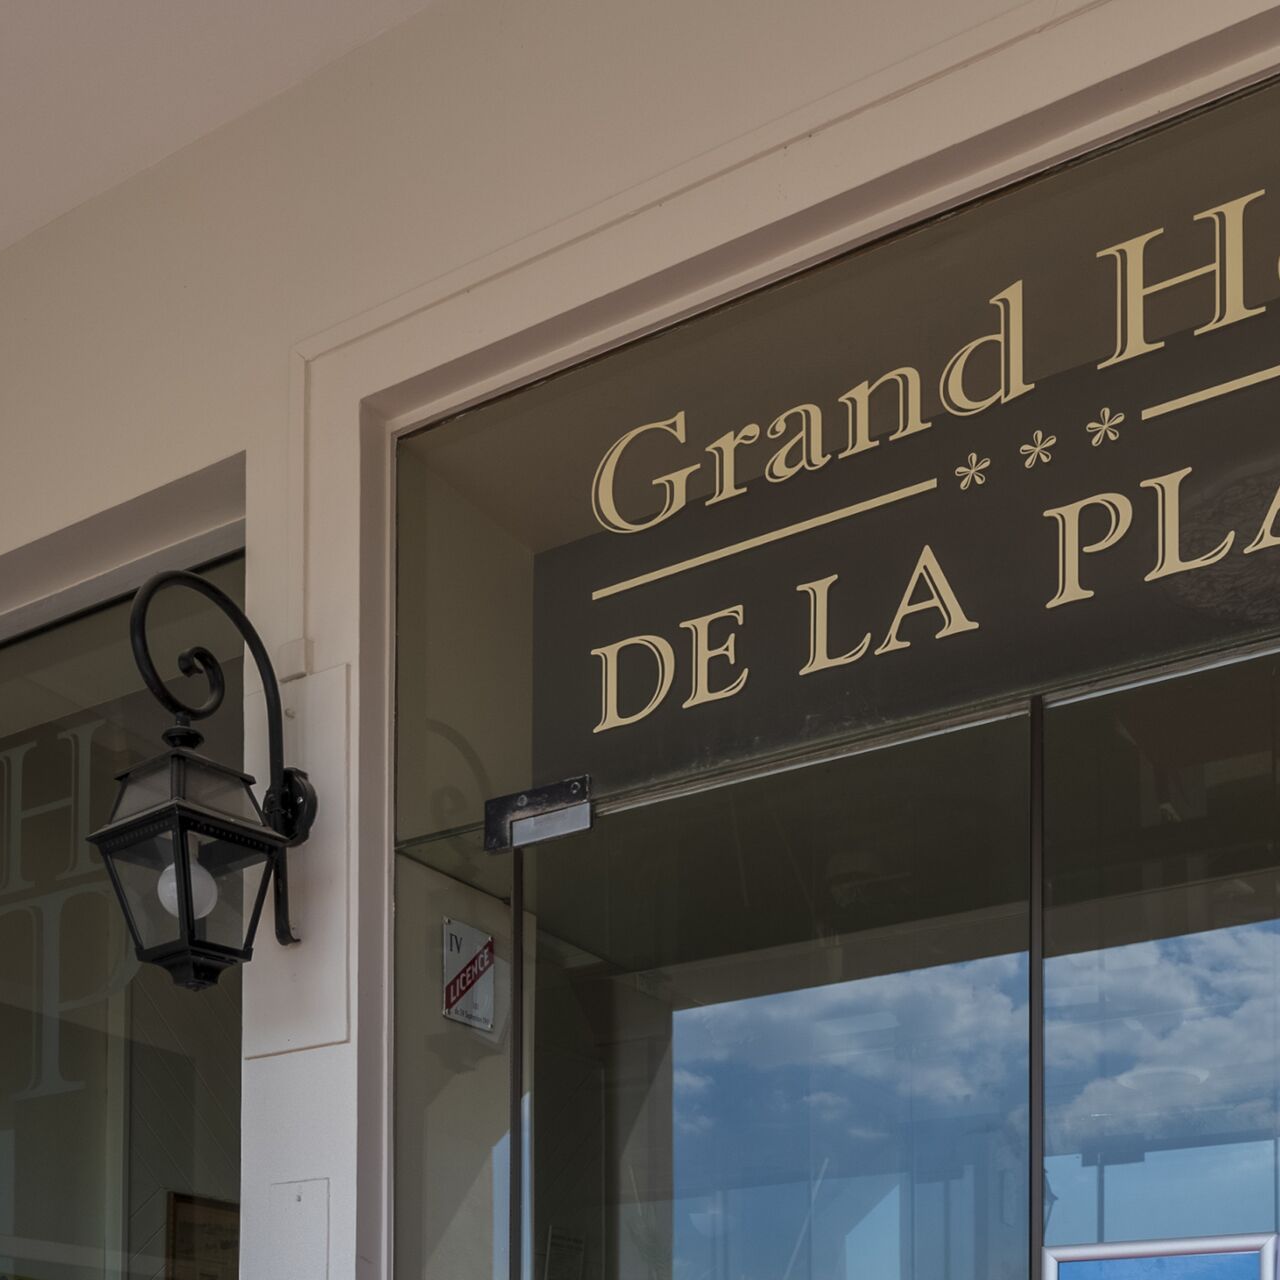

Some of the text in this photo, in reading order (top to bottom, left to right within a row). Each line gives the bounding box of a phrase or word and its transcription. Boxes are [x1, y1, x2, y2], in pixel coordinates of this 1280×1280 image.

[591, 279, 1036, 534] Grand
[591, 603, 749, 734] DE
[797, 543, 980, 677] LA
[449, 933, 463, 953] IV
[449, 947, 491, 1004] LICENCE
